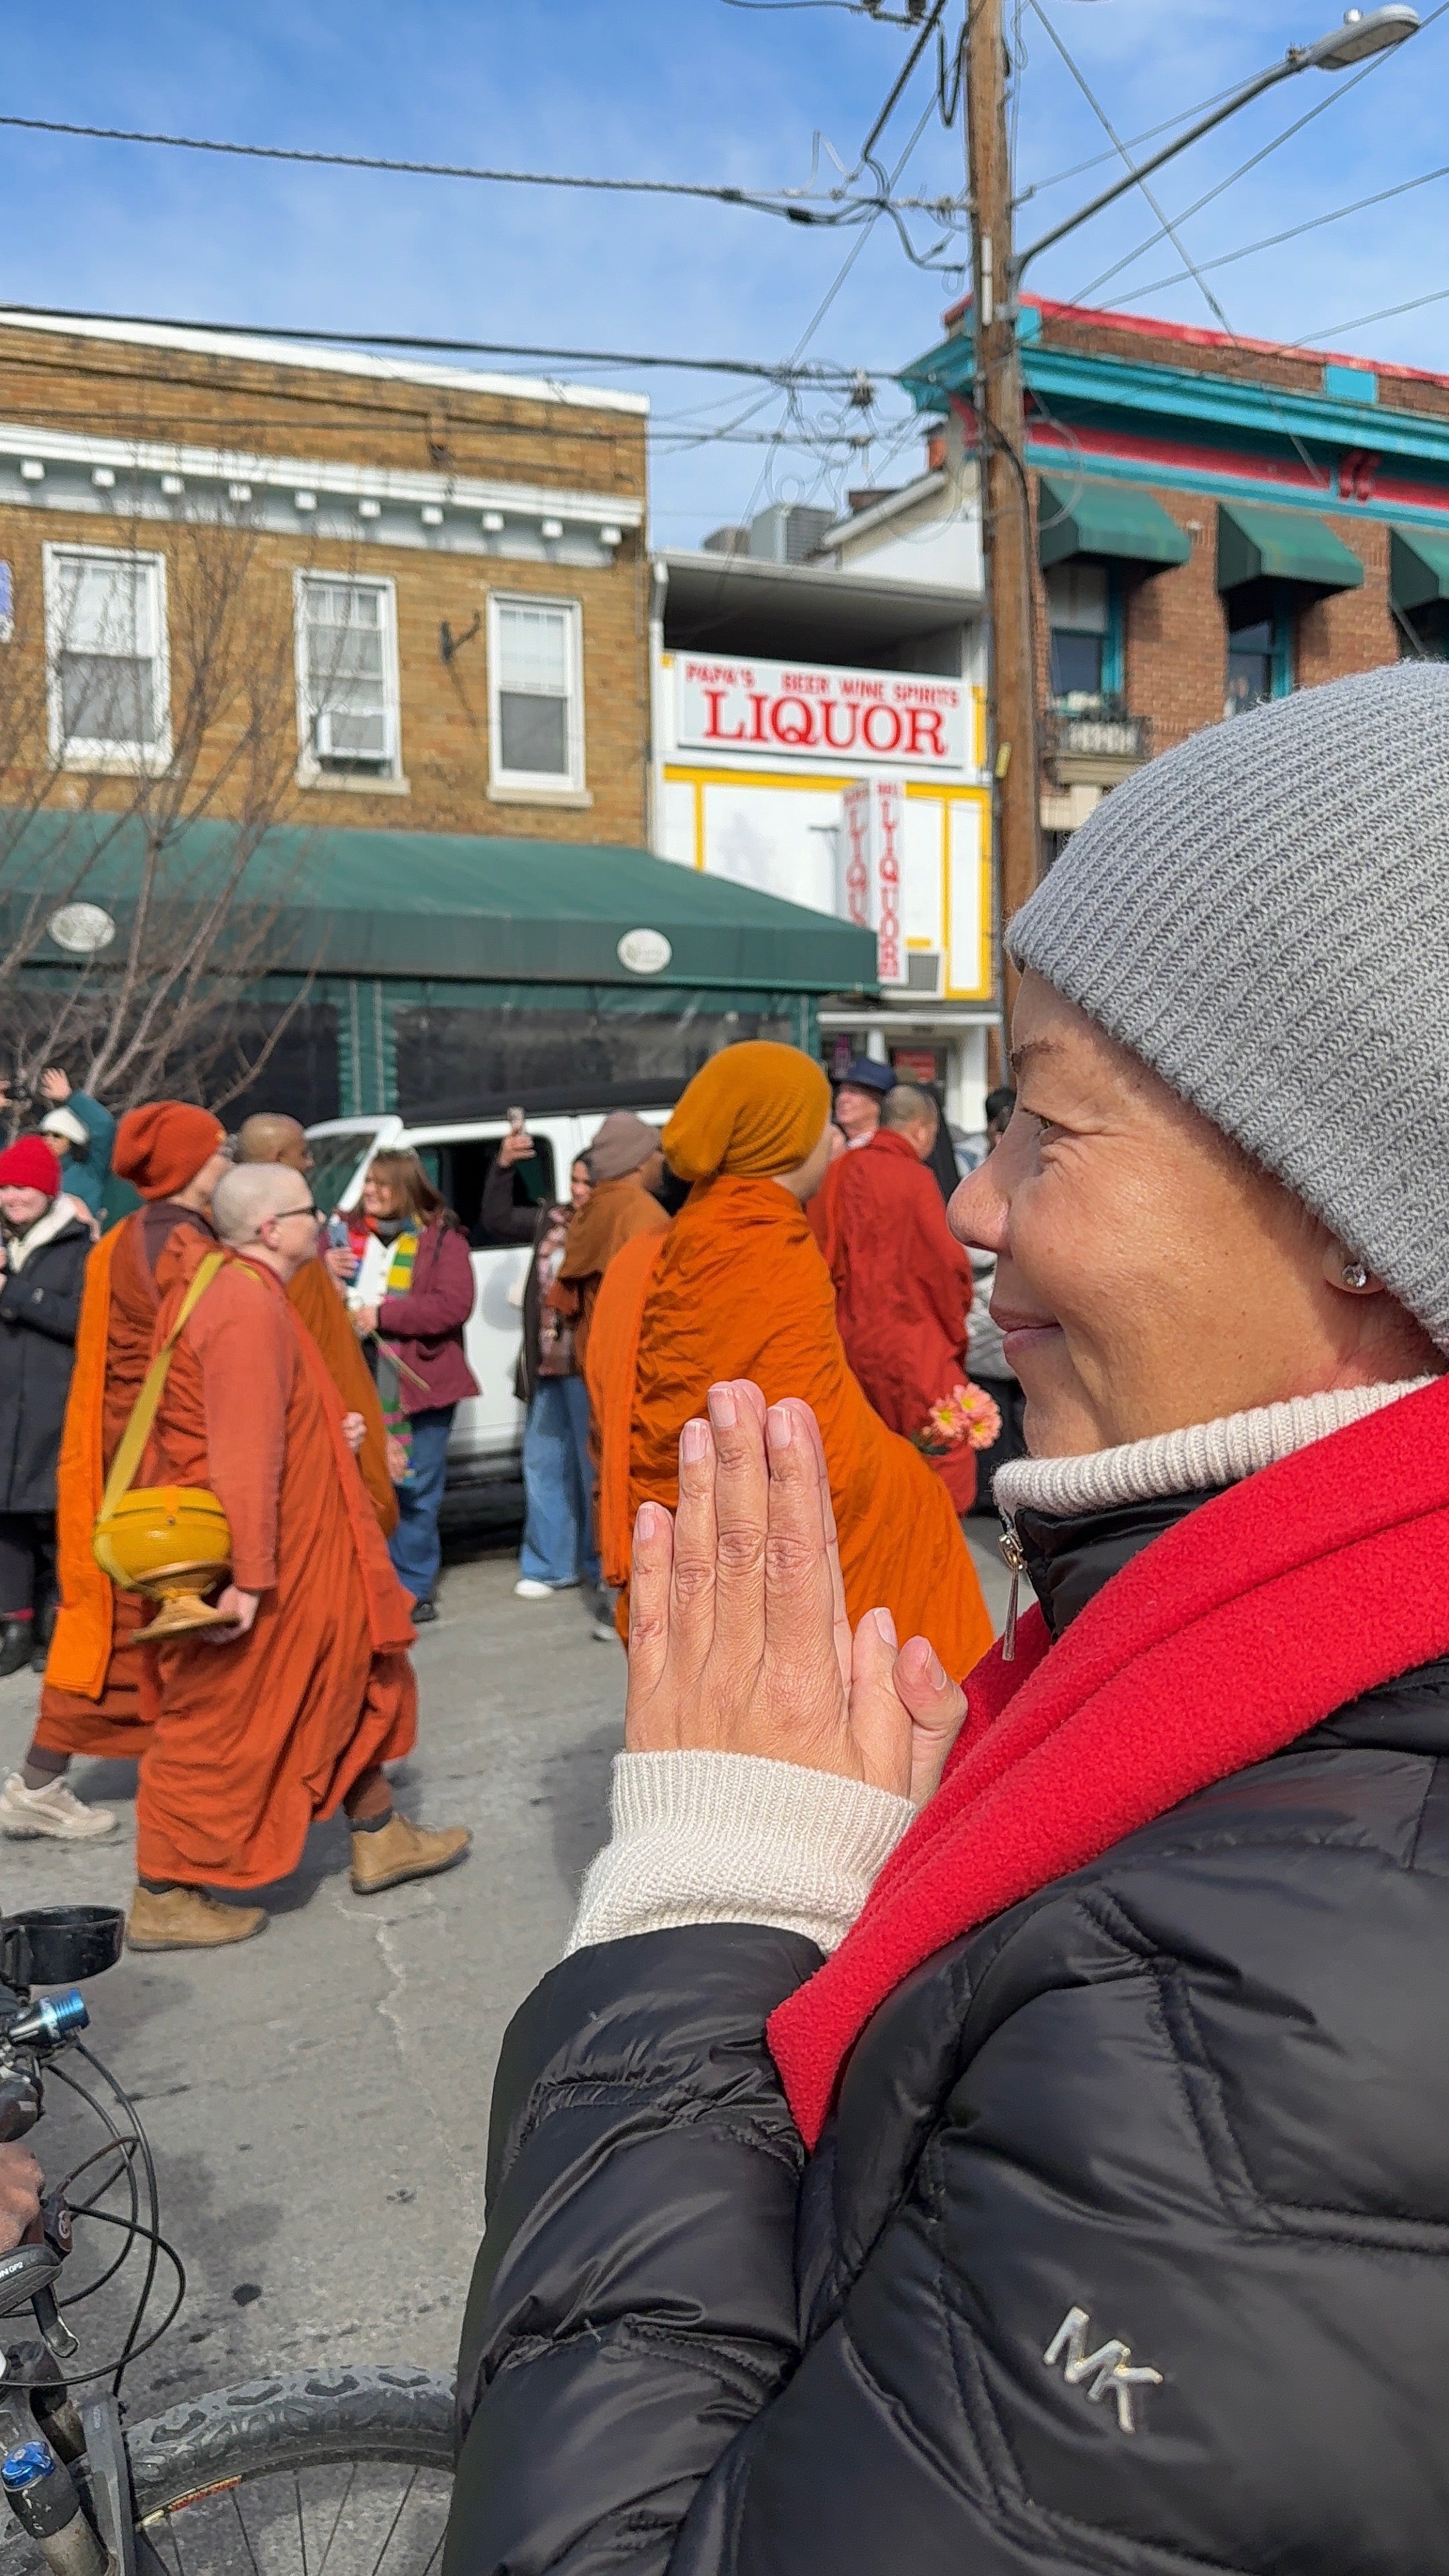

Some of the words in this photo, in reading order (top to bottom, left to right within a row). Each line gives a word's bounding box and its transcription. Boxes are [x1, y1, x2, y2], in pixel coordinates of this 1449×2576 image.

[705, 690, 946, 755] LIQUOR
[782, 673, 830, 694] BEER
[878, 800, 899, 977] LIQUOR
[1044, 2306, 1164, 2434] MK
